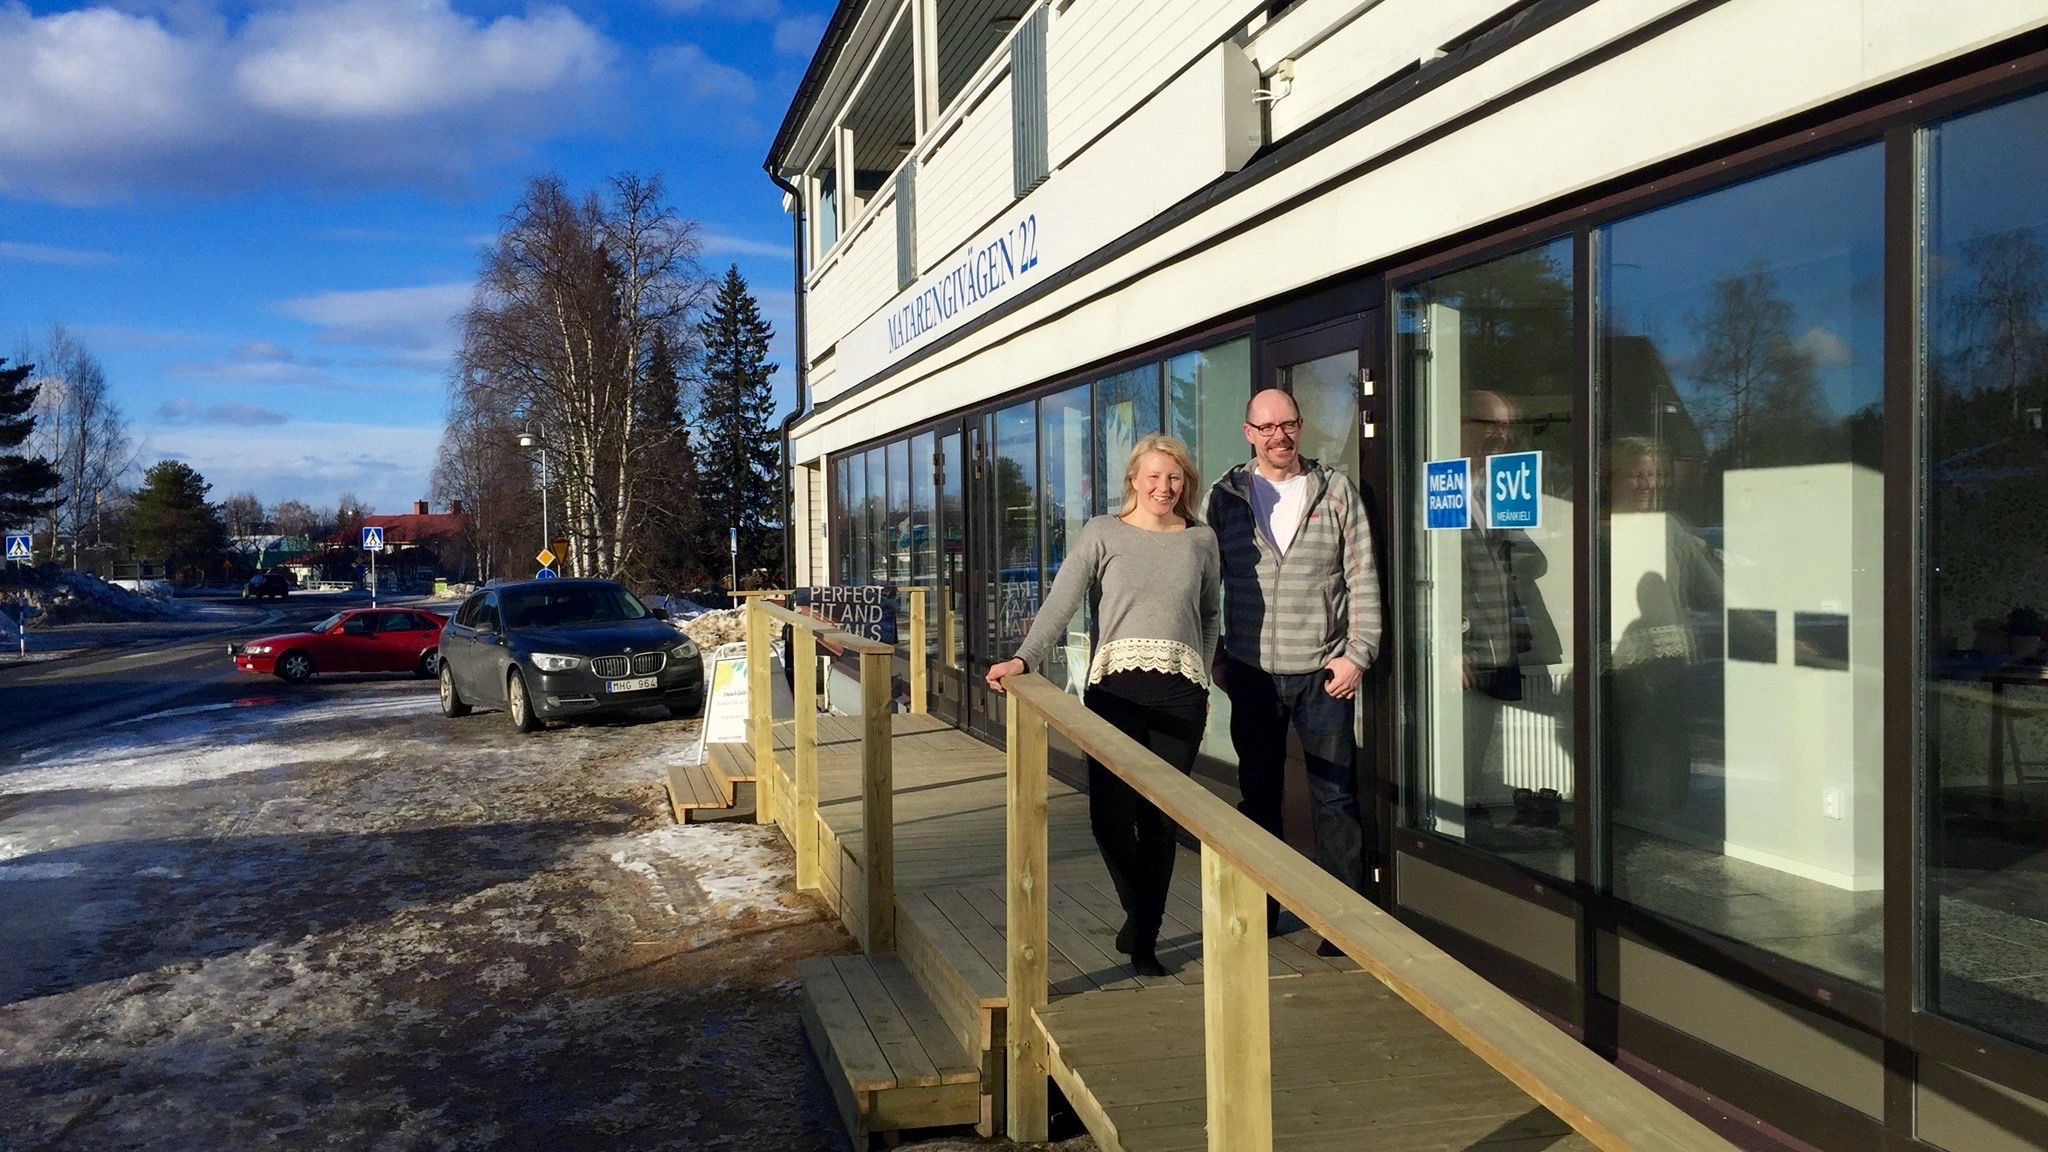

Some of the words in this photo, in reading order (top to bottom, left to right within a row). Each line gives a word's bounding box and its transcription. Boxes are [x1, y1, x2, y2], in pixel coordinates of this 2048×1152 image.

[888, 229, 1014, 353] MATARENGIVÄGEN
[1019, 214, 1038, 274] 22
[1430, 469, 1463, 492] MEÄN
[1496, 461, 1531, 502] svt
[1430, 494, 1463, 510] RAATIO
[1497, 510, 1531, 521] MEÄNKIELI
[810, 586, 885, 605] PERFECT
[809, 602, 837, 621] FIT
[840, 603, 883, 623] AND
[613, 681, 632, 691] MHG
[638, 679, 656, 689] 964
